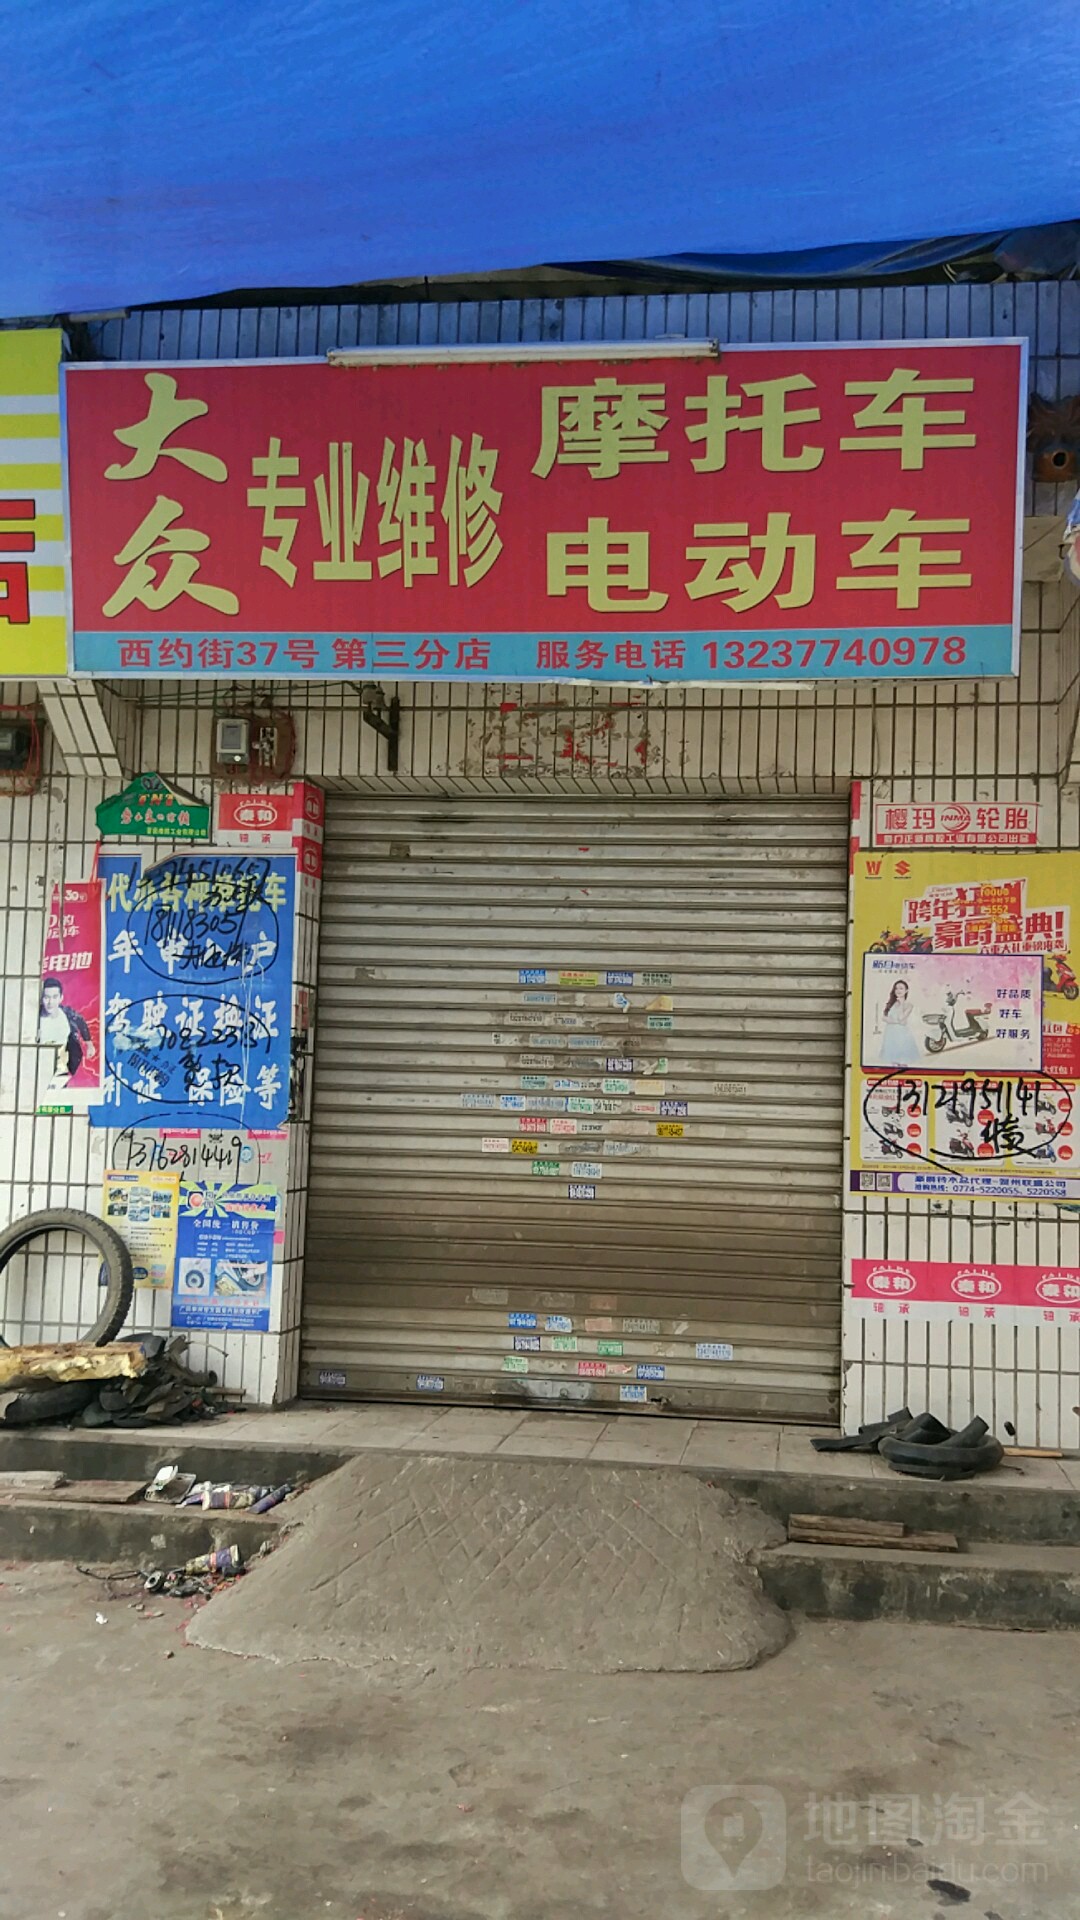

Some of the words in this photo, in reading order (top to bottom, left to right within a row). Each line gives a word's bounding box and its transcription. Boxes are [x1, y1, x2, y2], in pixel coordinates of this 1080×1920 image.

[531, 368, 976, 480] 摩托车
[102, 373, 239, 617] 大众
[247, 433, 503, 588] 专业维修
[546, 508, 972, 613] 电动车
[118, 638, 319, 670] 西约街37号
[331, 638, 491, 670] 第三分店
[536, 640, 686, 669] 服务电话
[702, 636, 966, 668] 13237740978
[885, 808, 935, 830] 樱玛
[976, 807, 1028, 830] 轮胎
[996, 988, 1032, 999] 好品质
[999, 1008, 1022, 1019] 好车
[996, 1028, 1031, 1039] 好服务
